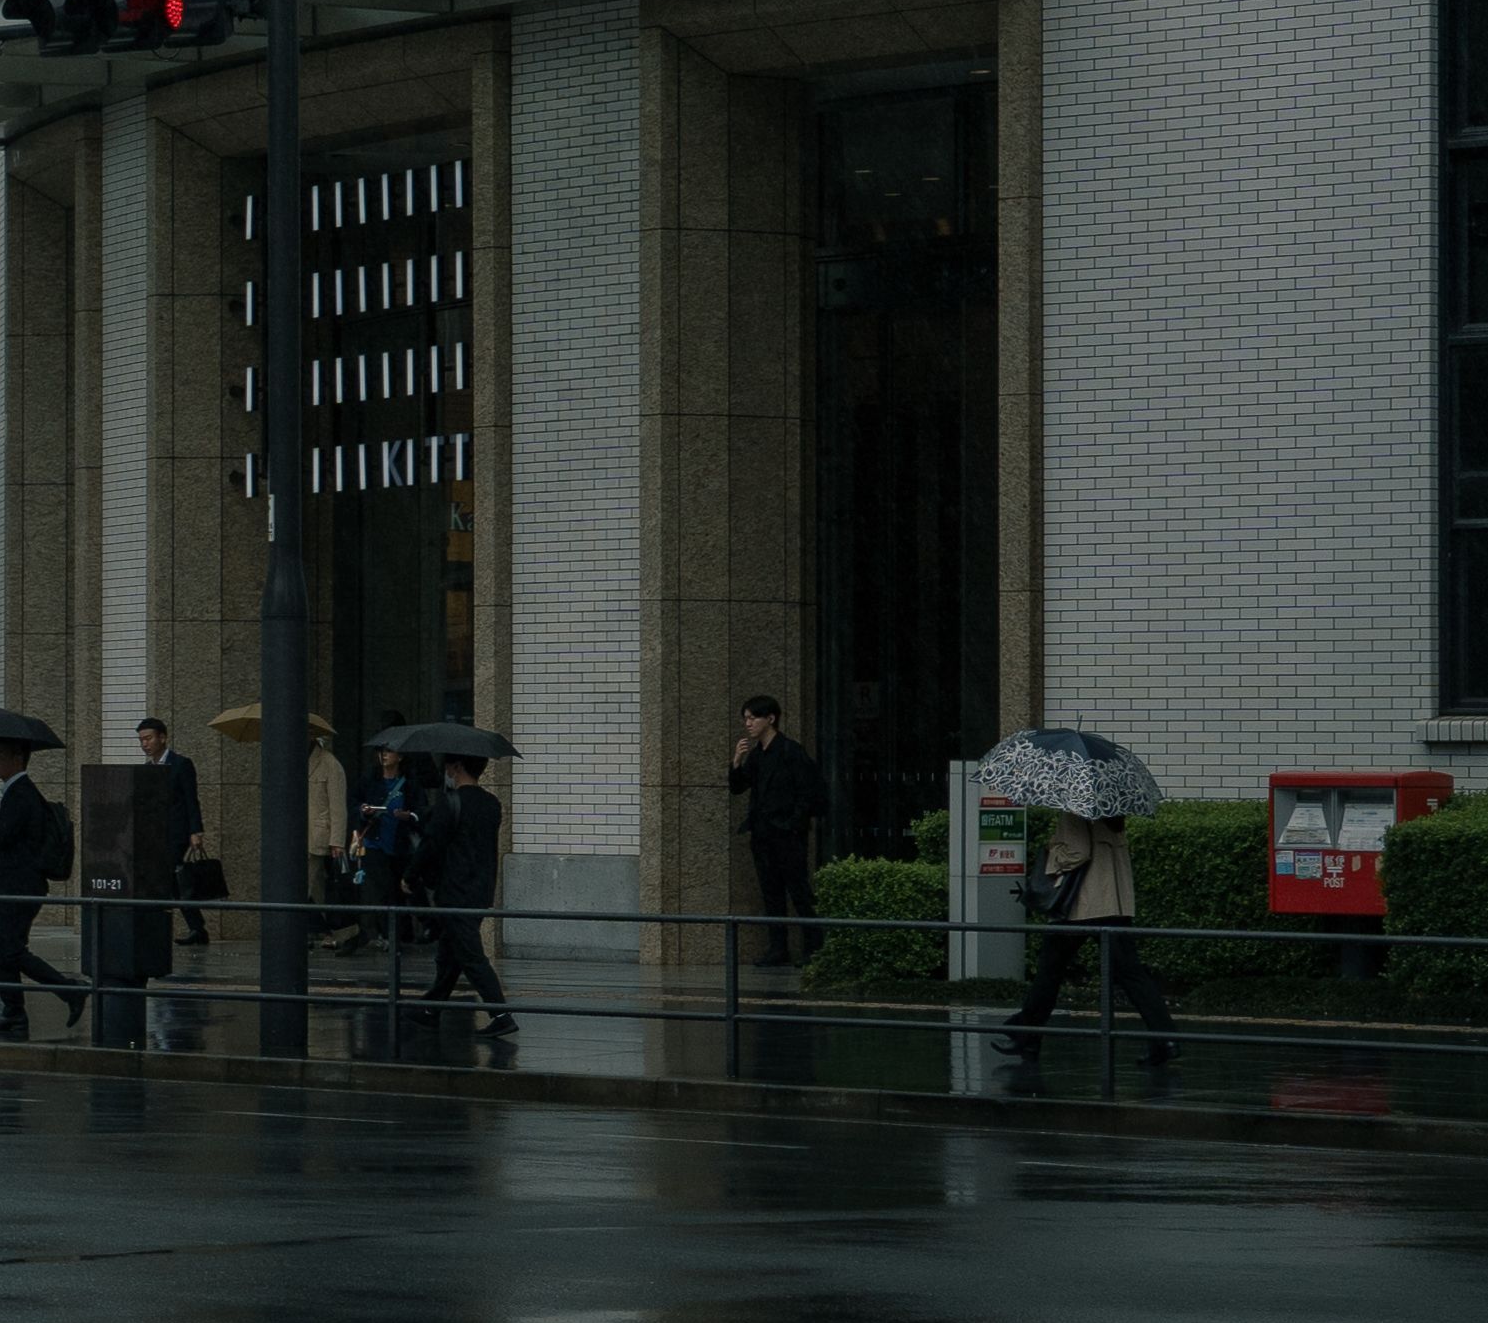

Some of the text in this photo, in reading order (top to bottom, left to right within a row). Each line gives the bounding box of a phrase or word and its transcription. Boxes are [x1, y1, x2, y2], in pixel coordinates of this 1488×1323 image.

[981, 814, 1014, 827] 銀行ATM
[91, 878, 122, 890] 101-21
[1323, 877, 1345, 888] POST
